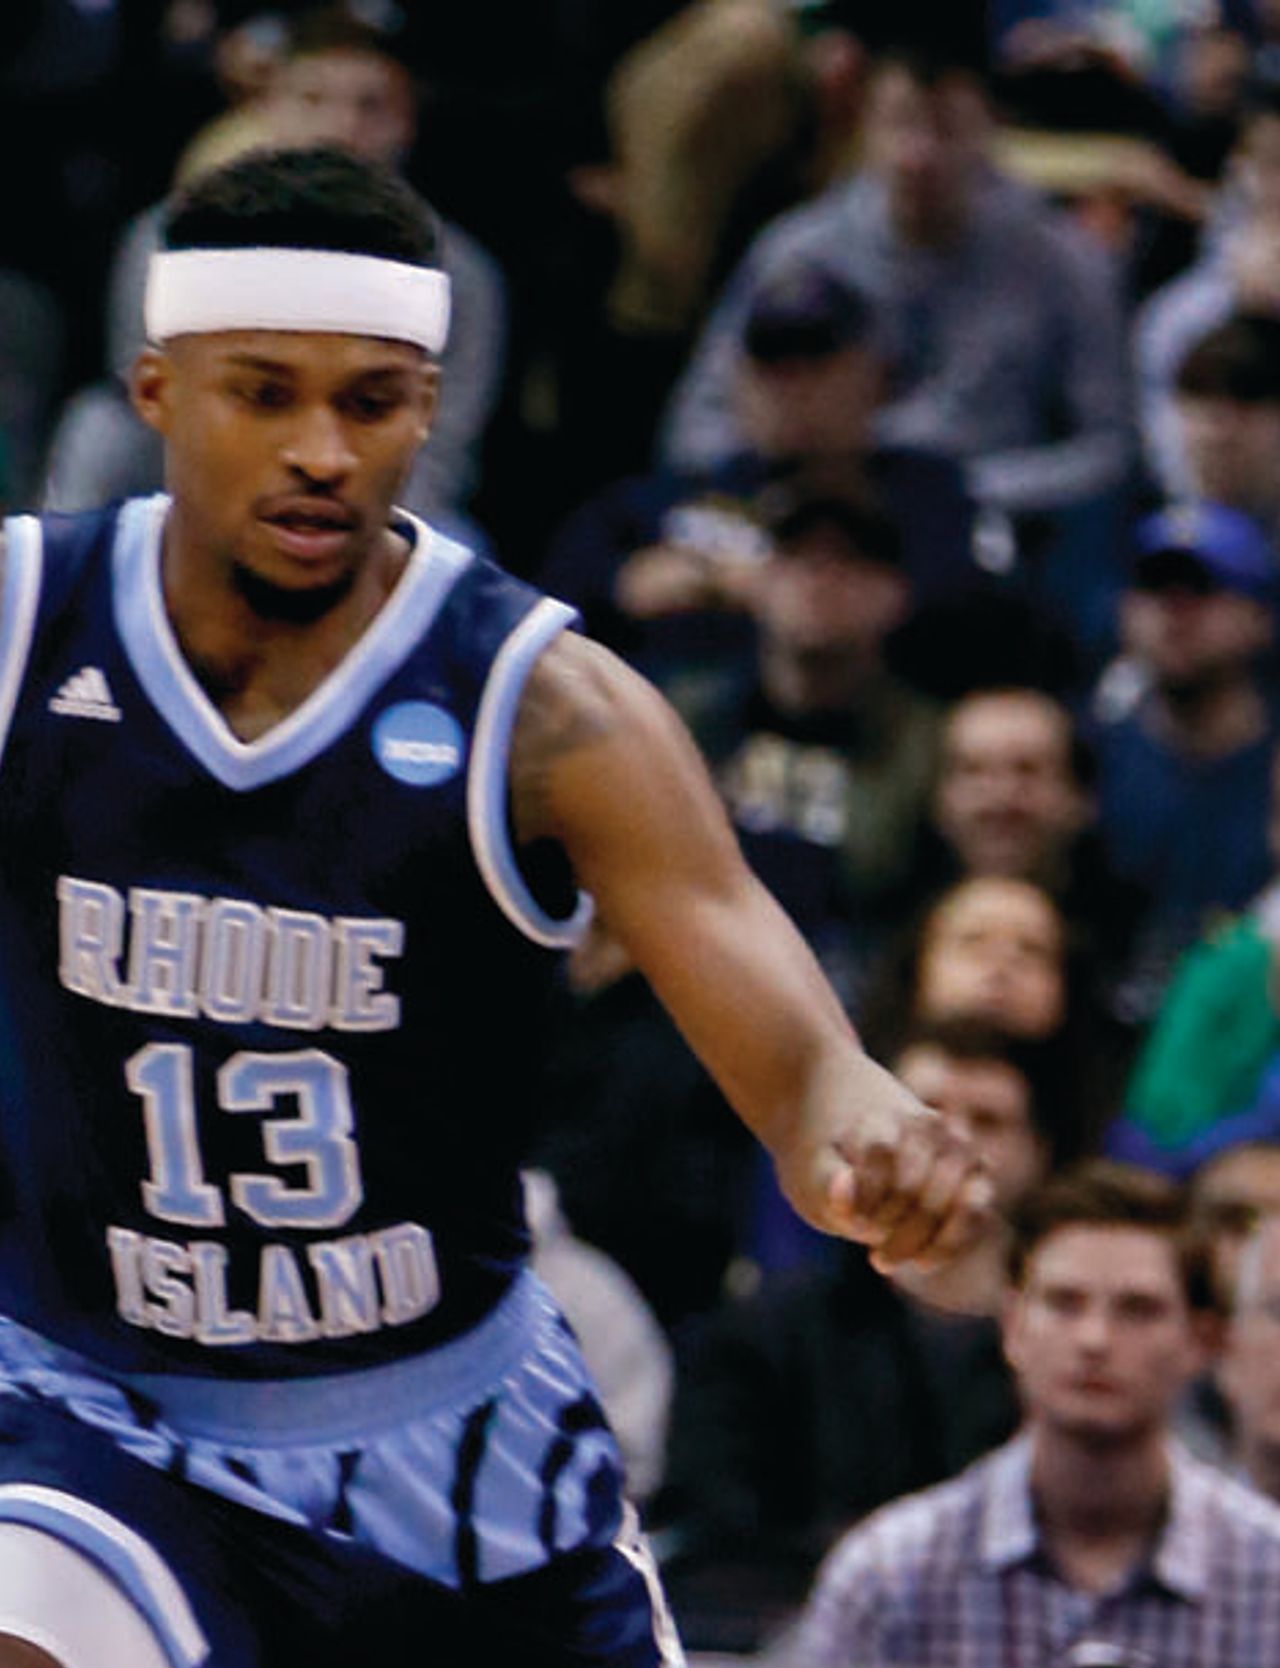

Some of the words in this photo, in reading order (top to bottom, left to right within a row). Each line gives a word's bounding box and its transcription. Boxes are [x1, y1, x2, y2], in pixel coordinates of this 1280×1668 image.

[56, 874, 405, 1033] RHODE
[125, 1041, 365, 1230] 13
[106, 1220, 442, 1347] ISLAND
